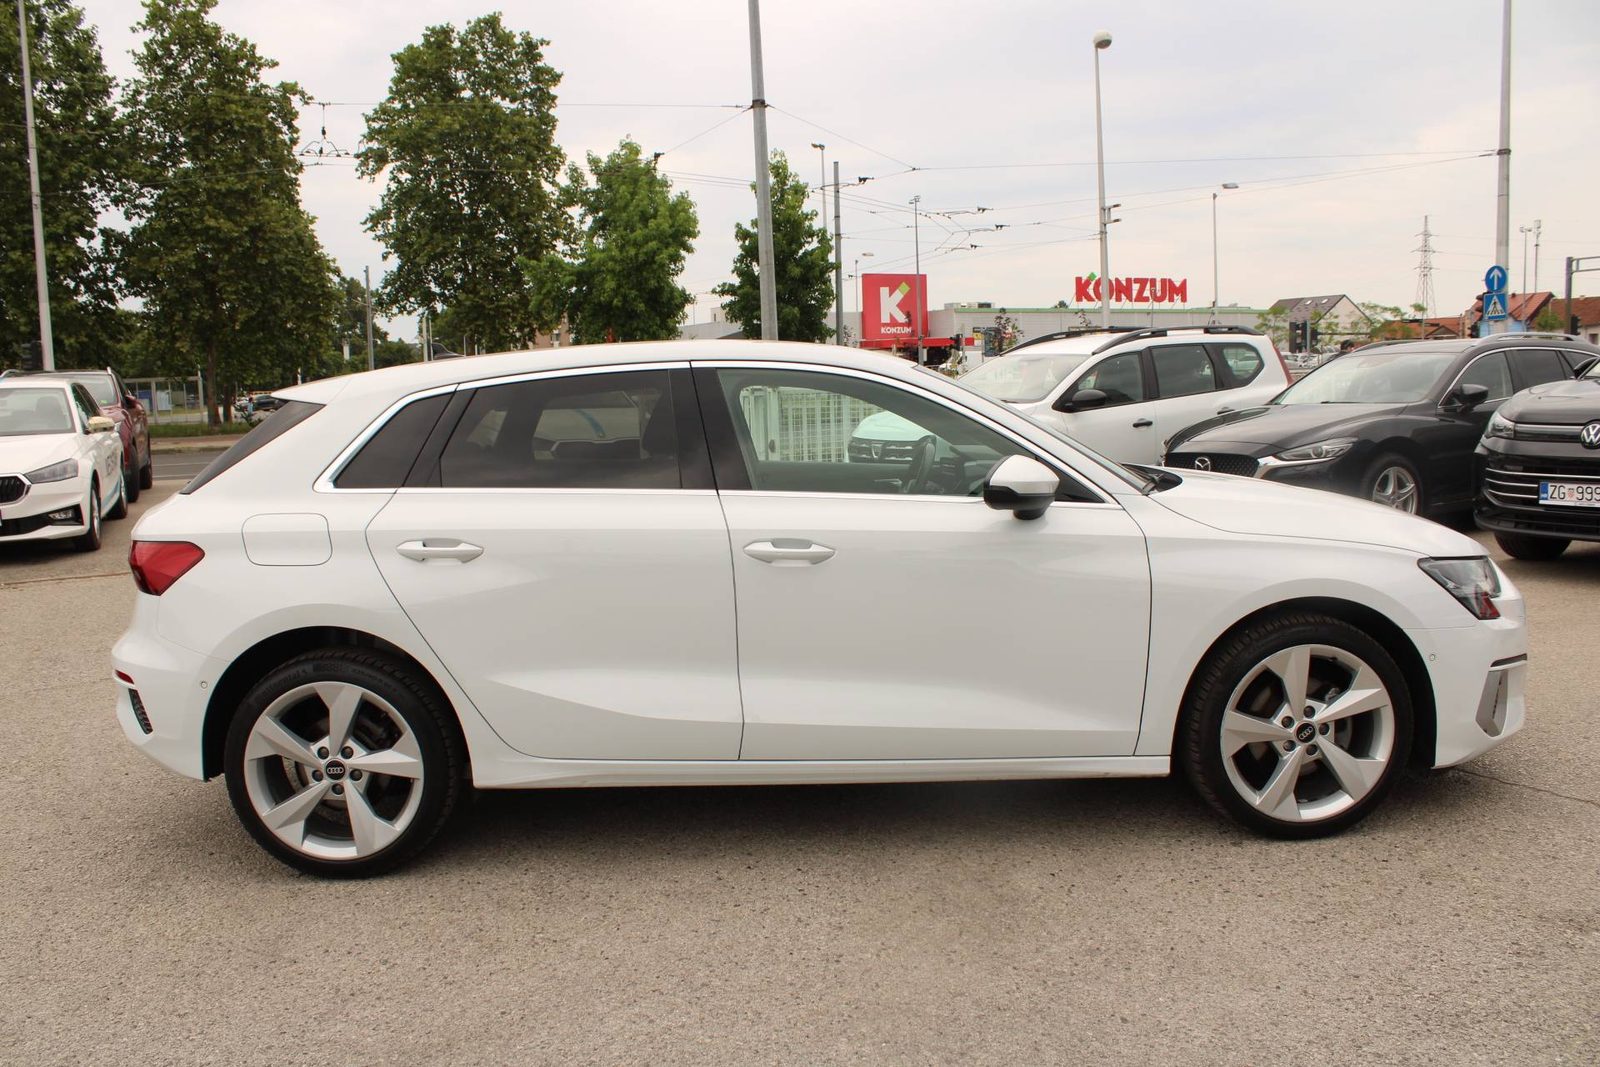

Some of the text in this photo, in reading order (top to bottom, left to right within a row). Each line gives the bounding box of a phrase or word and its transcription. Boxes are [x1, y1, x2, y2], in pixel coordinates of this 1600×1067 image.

[880, 282, 910, 323] K
[1075, 272, 1187, 303] KONZUM
[1550, 485, 1566, 500] ZG
